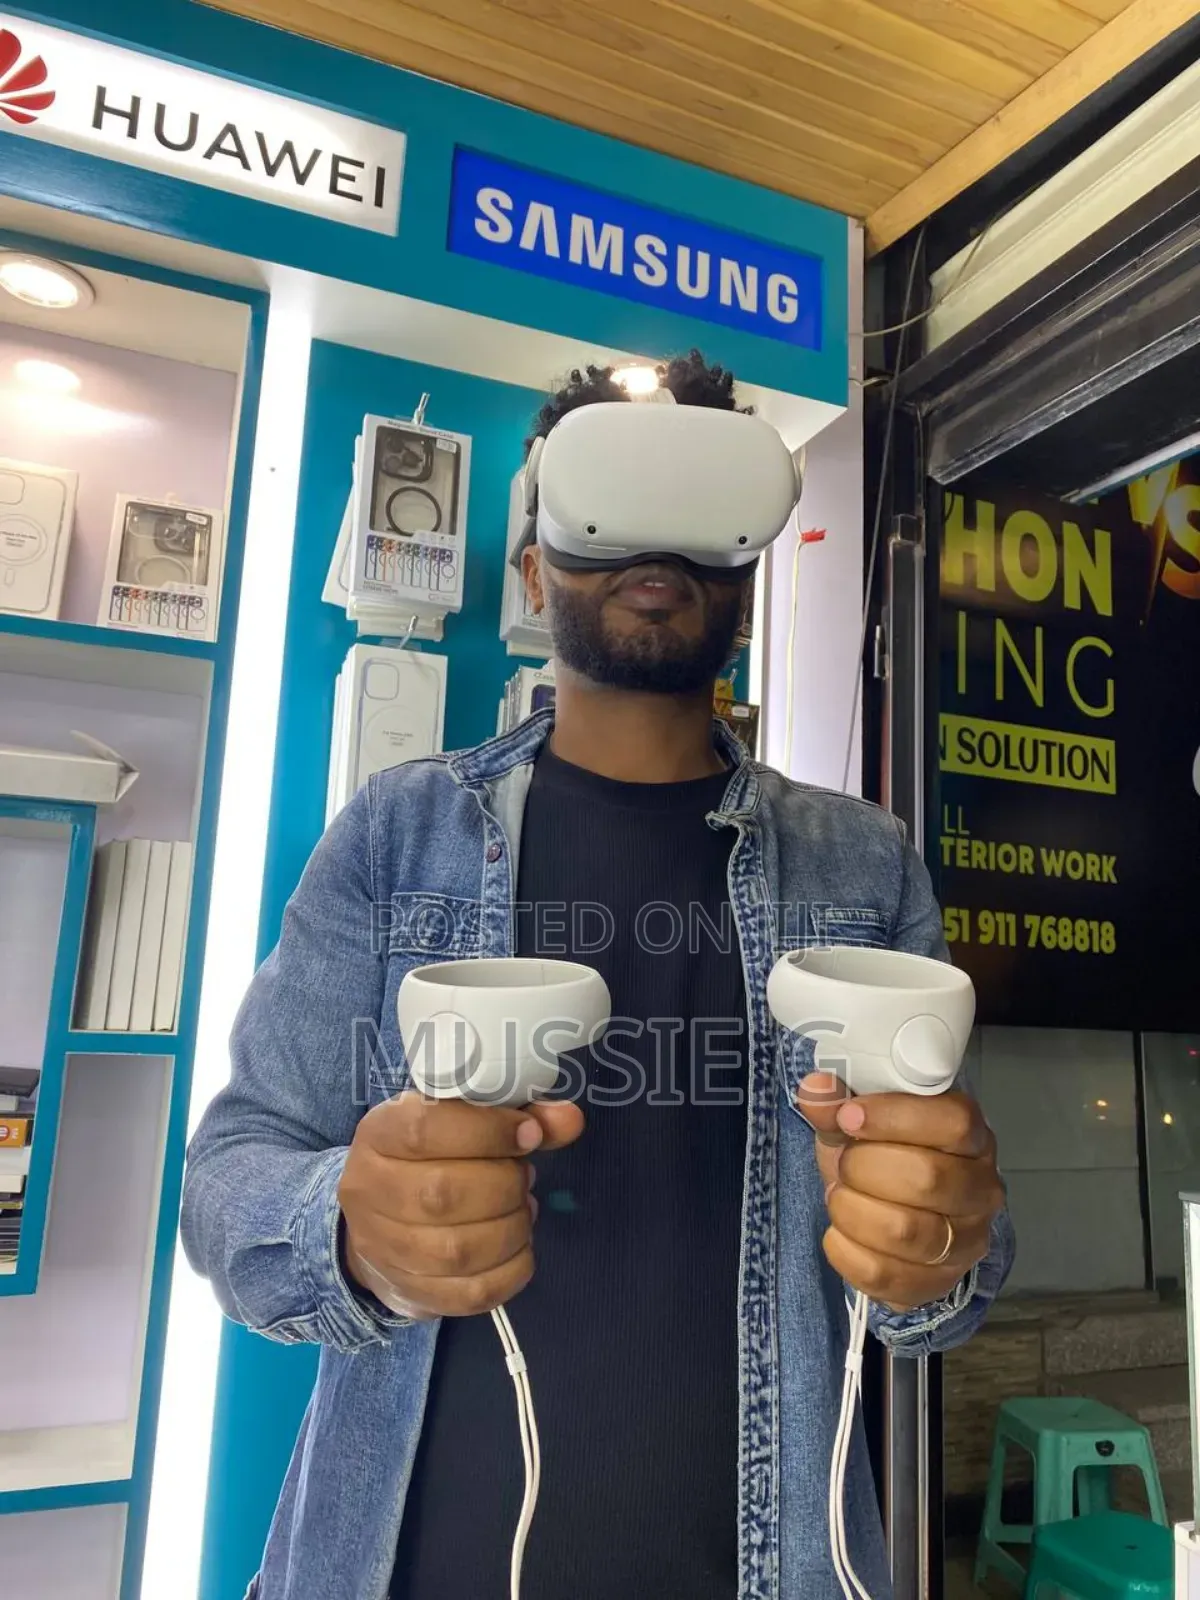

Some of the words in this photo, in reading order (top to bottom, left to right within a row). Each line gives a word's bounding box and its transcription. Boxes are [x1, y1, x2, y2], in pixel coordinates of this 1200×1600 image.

[91, 84, 386, 209] HUAWEI
[474, 186, 799, 325] SAMSUNG
[956, 726, 1111, 785] SOLUTION
[939, 835, 1036, 877] TERIOR
[1039, 846, 1118, 885] WORK
[977, 908, 1018, 947] 911
[1023, 913, 1116, 955] 768818
